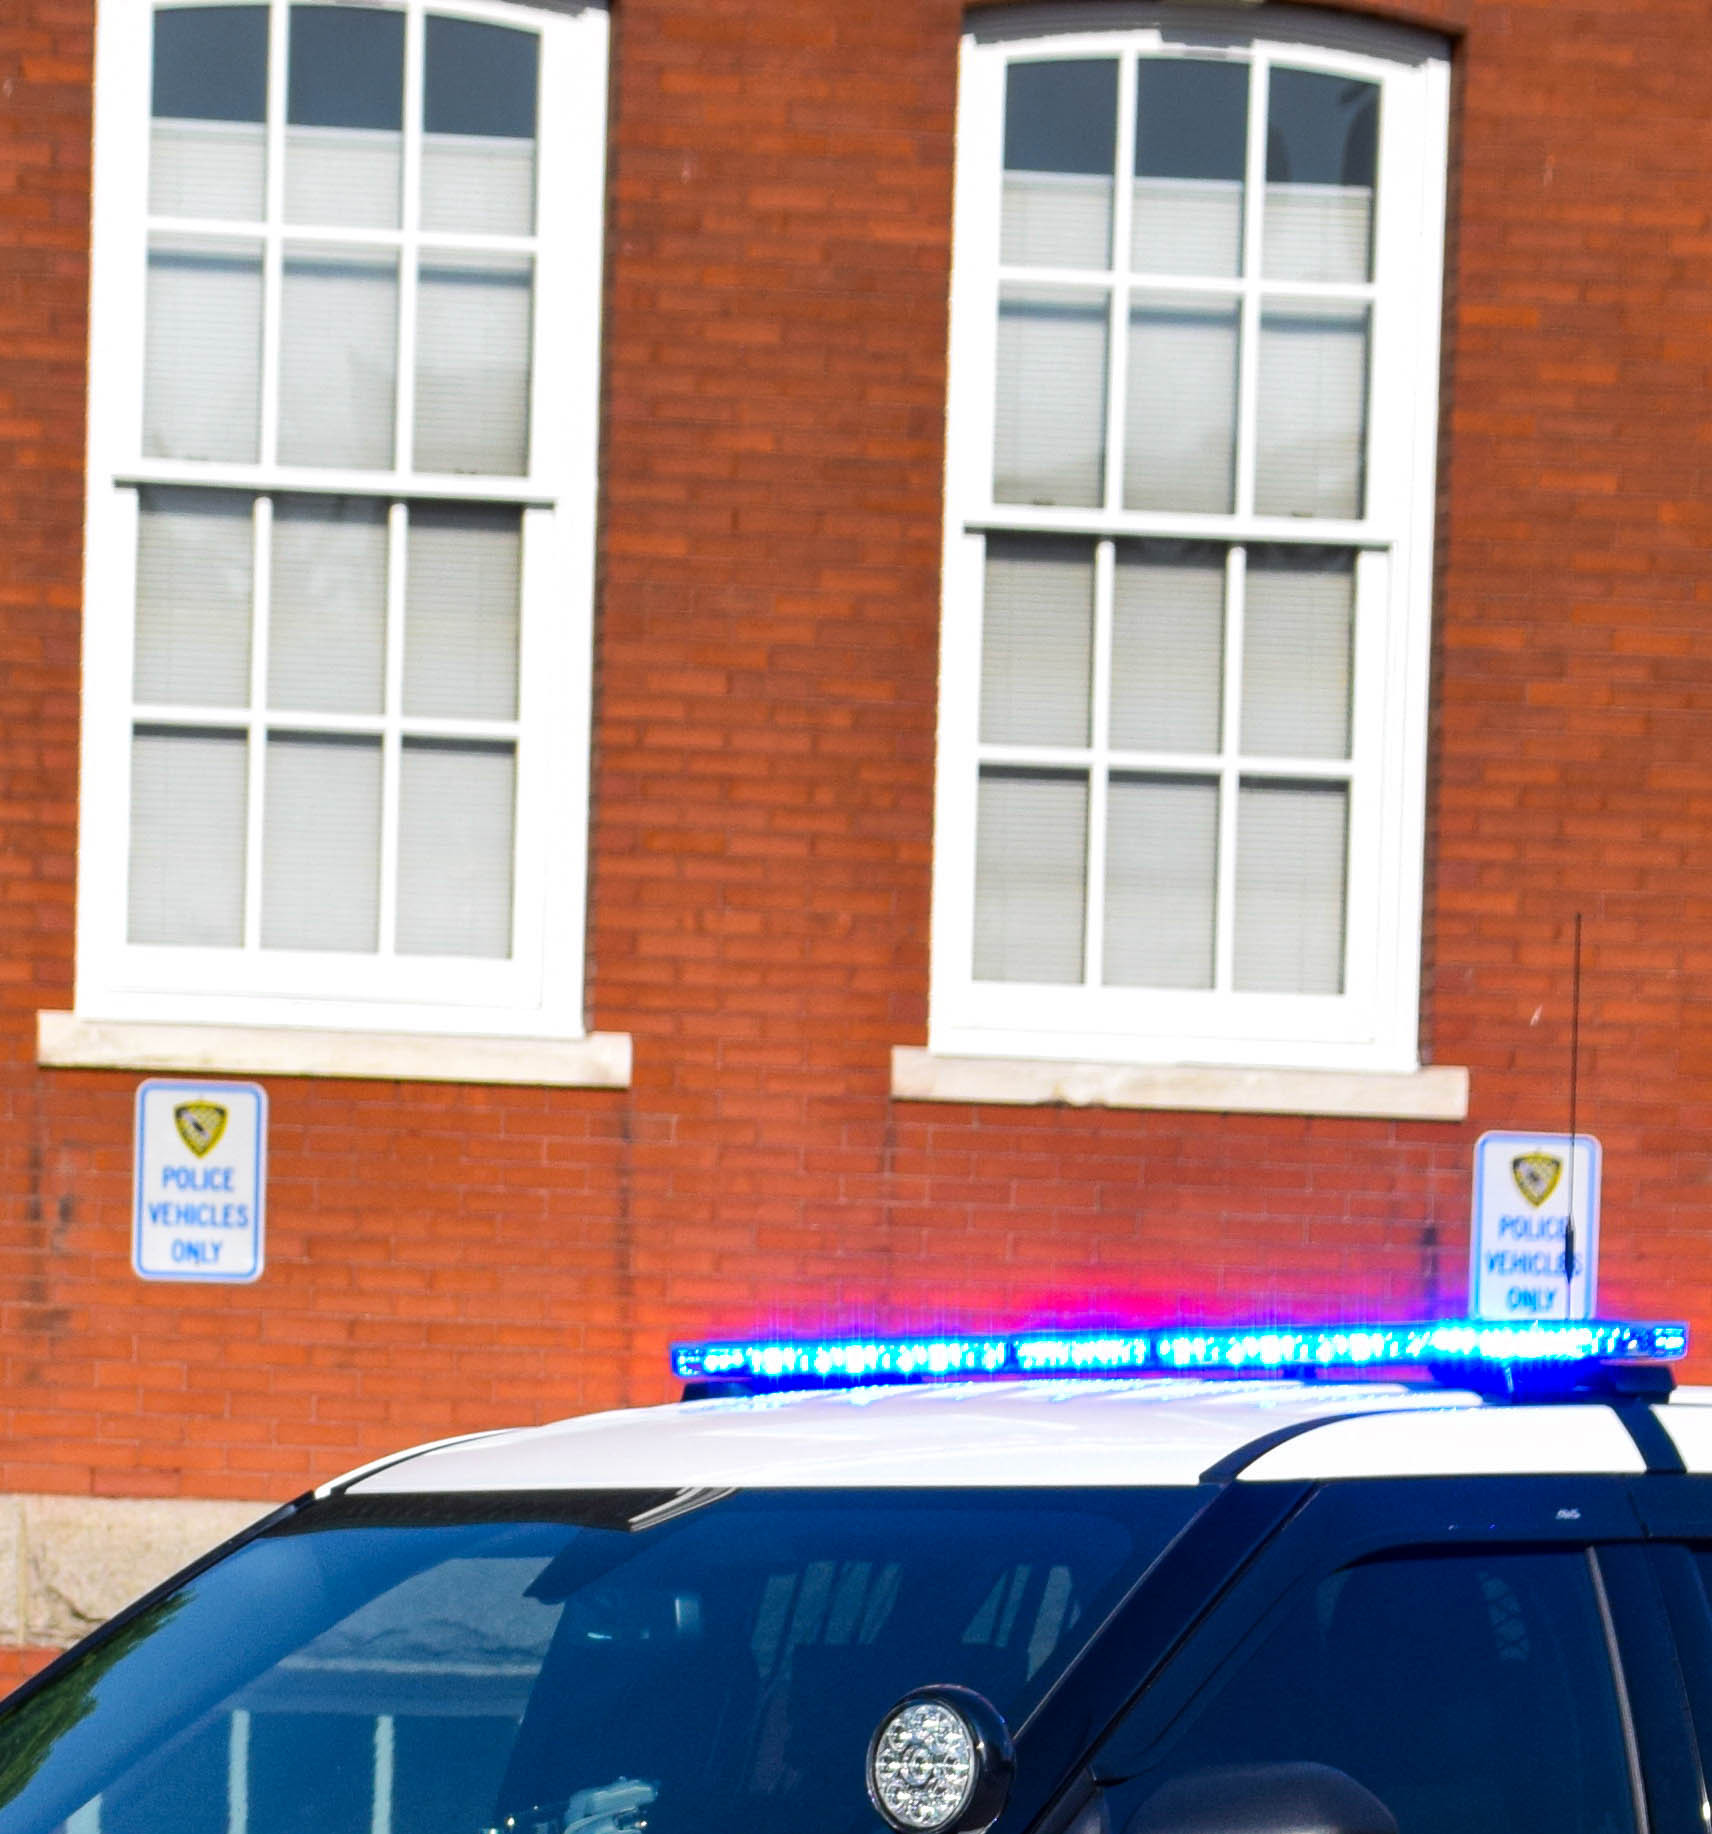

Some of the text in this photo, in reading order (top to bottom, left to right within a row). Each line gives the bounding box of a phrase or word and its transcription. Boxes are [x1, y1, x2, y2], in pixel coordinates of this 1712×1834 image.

[162, 1165, 235, 1192] POLICE
[148, 1202, 249, 1229] VEHICLES
[170, 1239, 223, 1264] ONLY
[1506, 1286, 1557, 1312] ONLY
